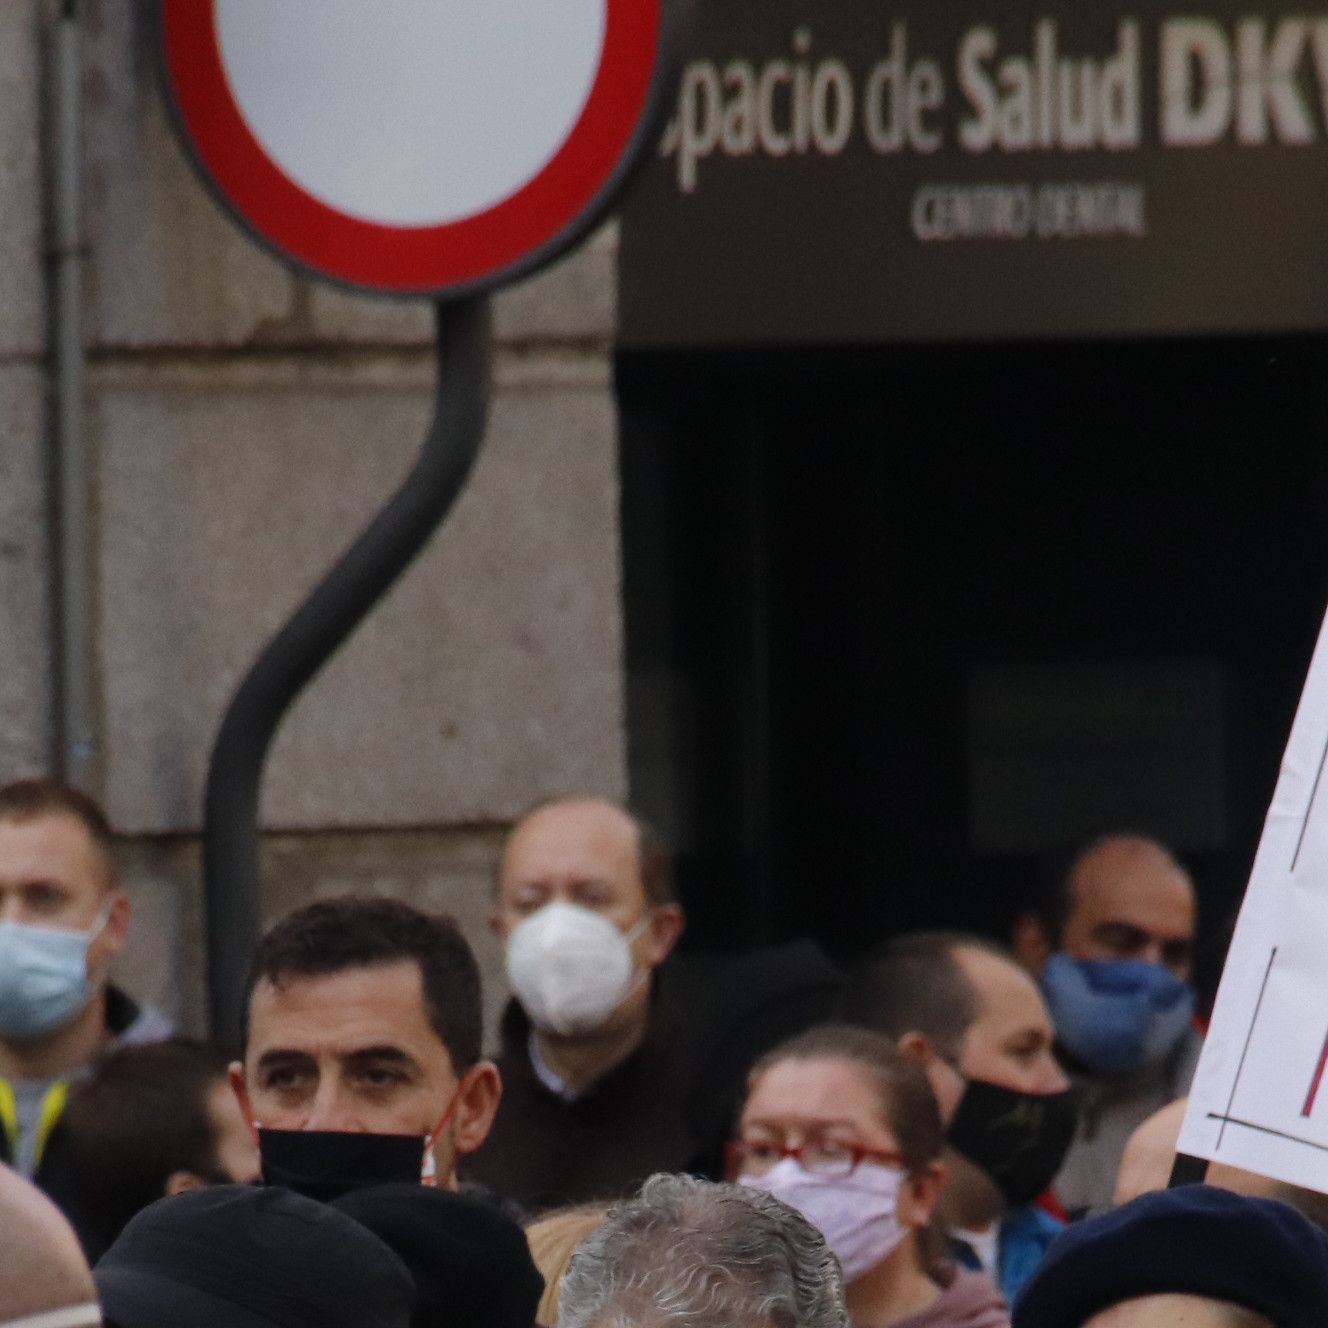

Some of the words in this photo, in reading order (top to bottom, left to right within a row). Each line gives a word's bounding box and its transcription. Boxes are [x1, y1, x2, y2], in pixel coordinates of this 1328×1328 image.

[660, 26, 853, 193] pacio
[864, 22, 943, 153] de
[958, 20, 1140, 153] Salud
[911, 183, 1032, 240] CENTRO
[1036, 183, 1146, 238] DENTAL
